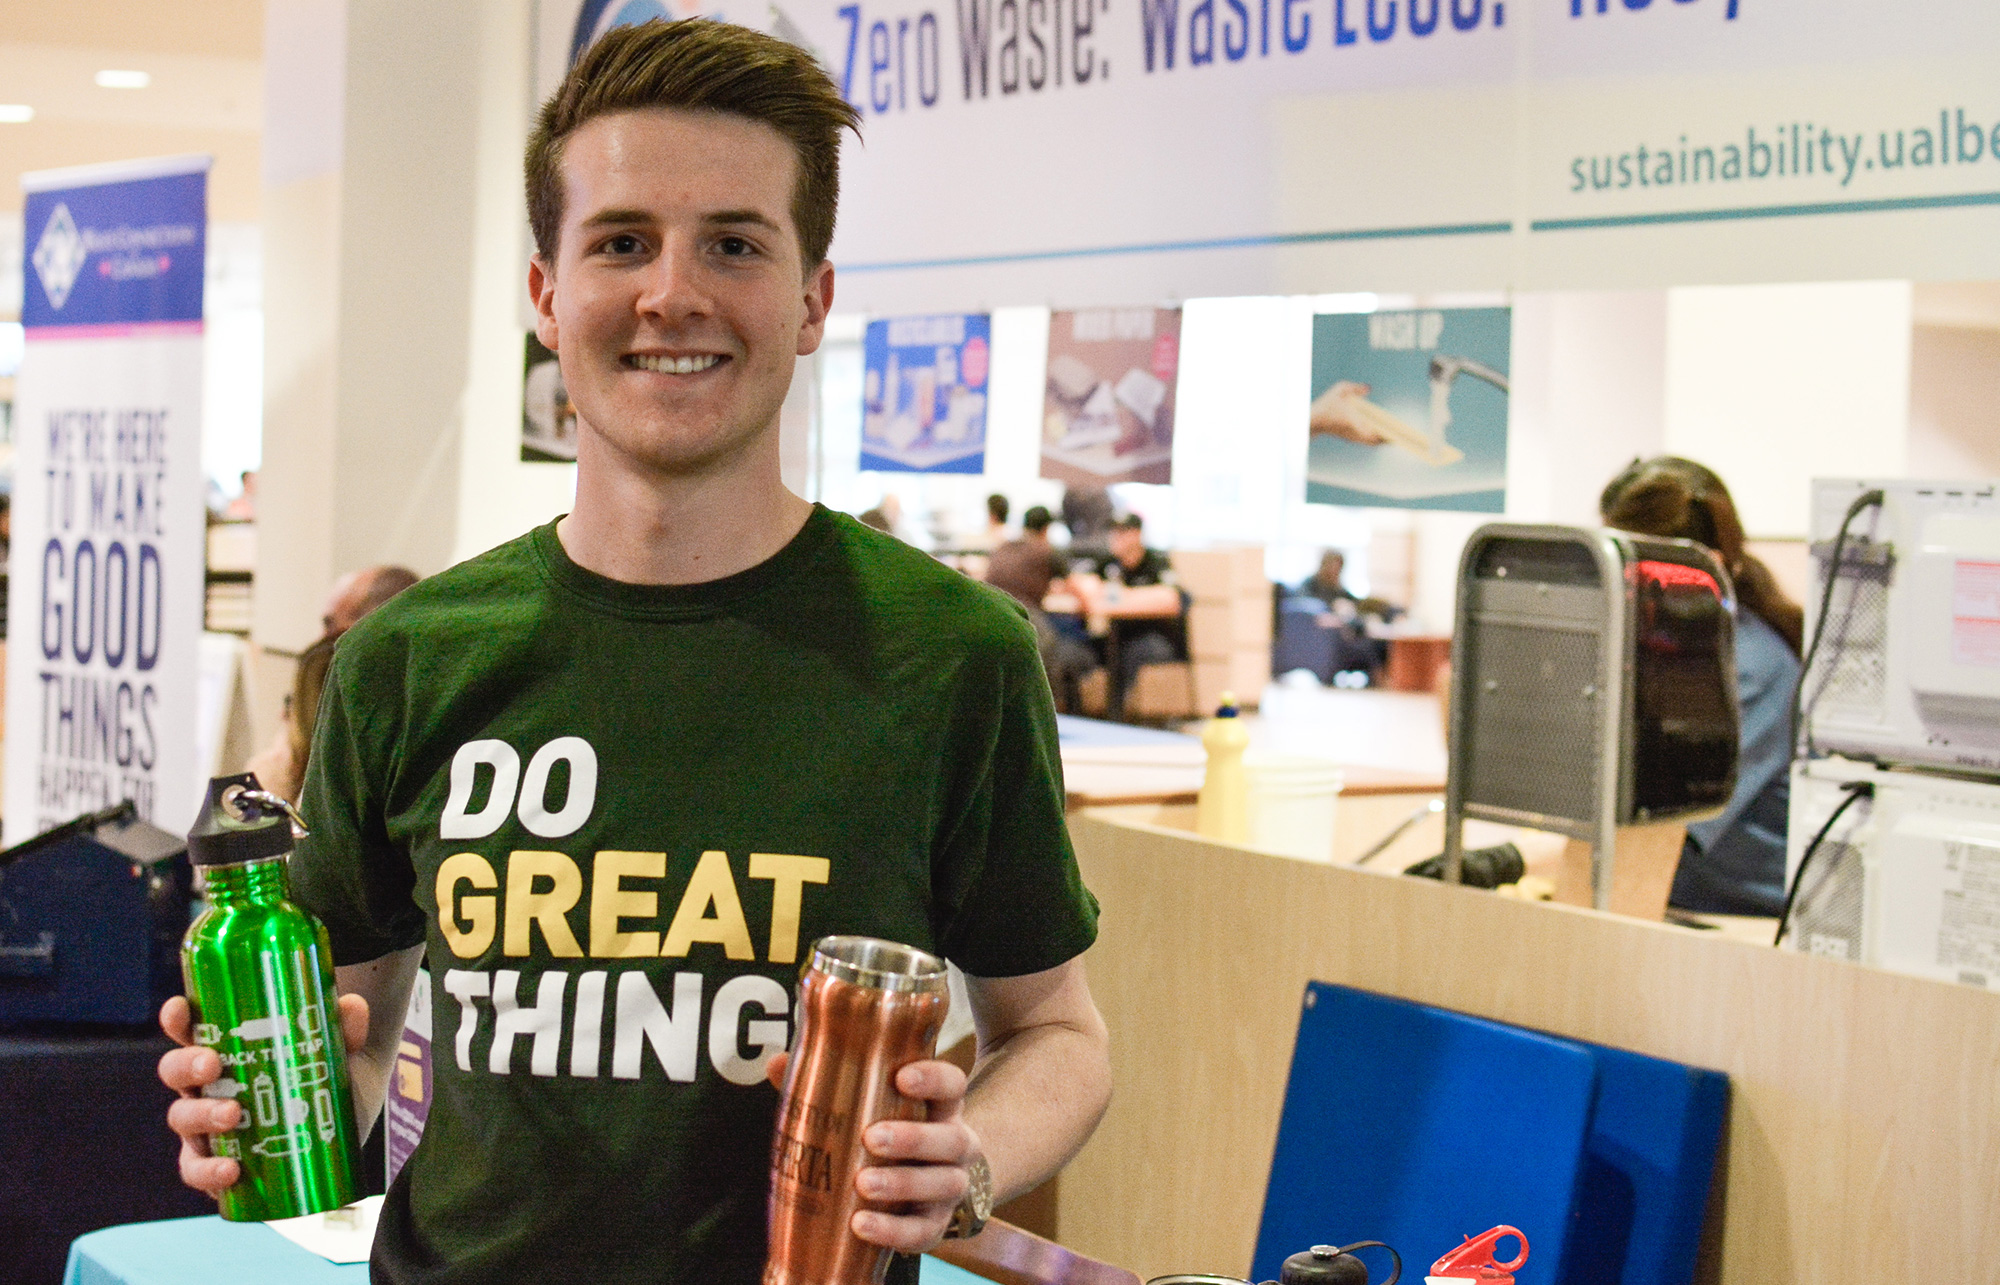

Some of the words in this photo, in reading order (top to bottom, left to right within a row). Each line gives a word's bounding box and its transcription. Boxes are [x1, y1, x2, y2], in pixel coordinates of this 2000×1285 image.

[838, 4, 940, 114] Zero
[956, 0, 1110, 100] Waste:
[115, 409, 169, 464] HERE
[45, 469, 76, 532] TO
[90, 471, 166, 537] MAKE
[40, 538, 162, 671] GOOD
[39, 672, 158, 771] THINGS
[440, 736, 598, 839] DO
[435, 850, 831, 964] GREAT
[444, 968, 800, 1086] THING
